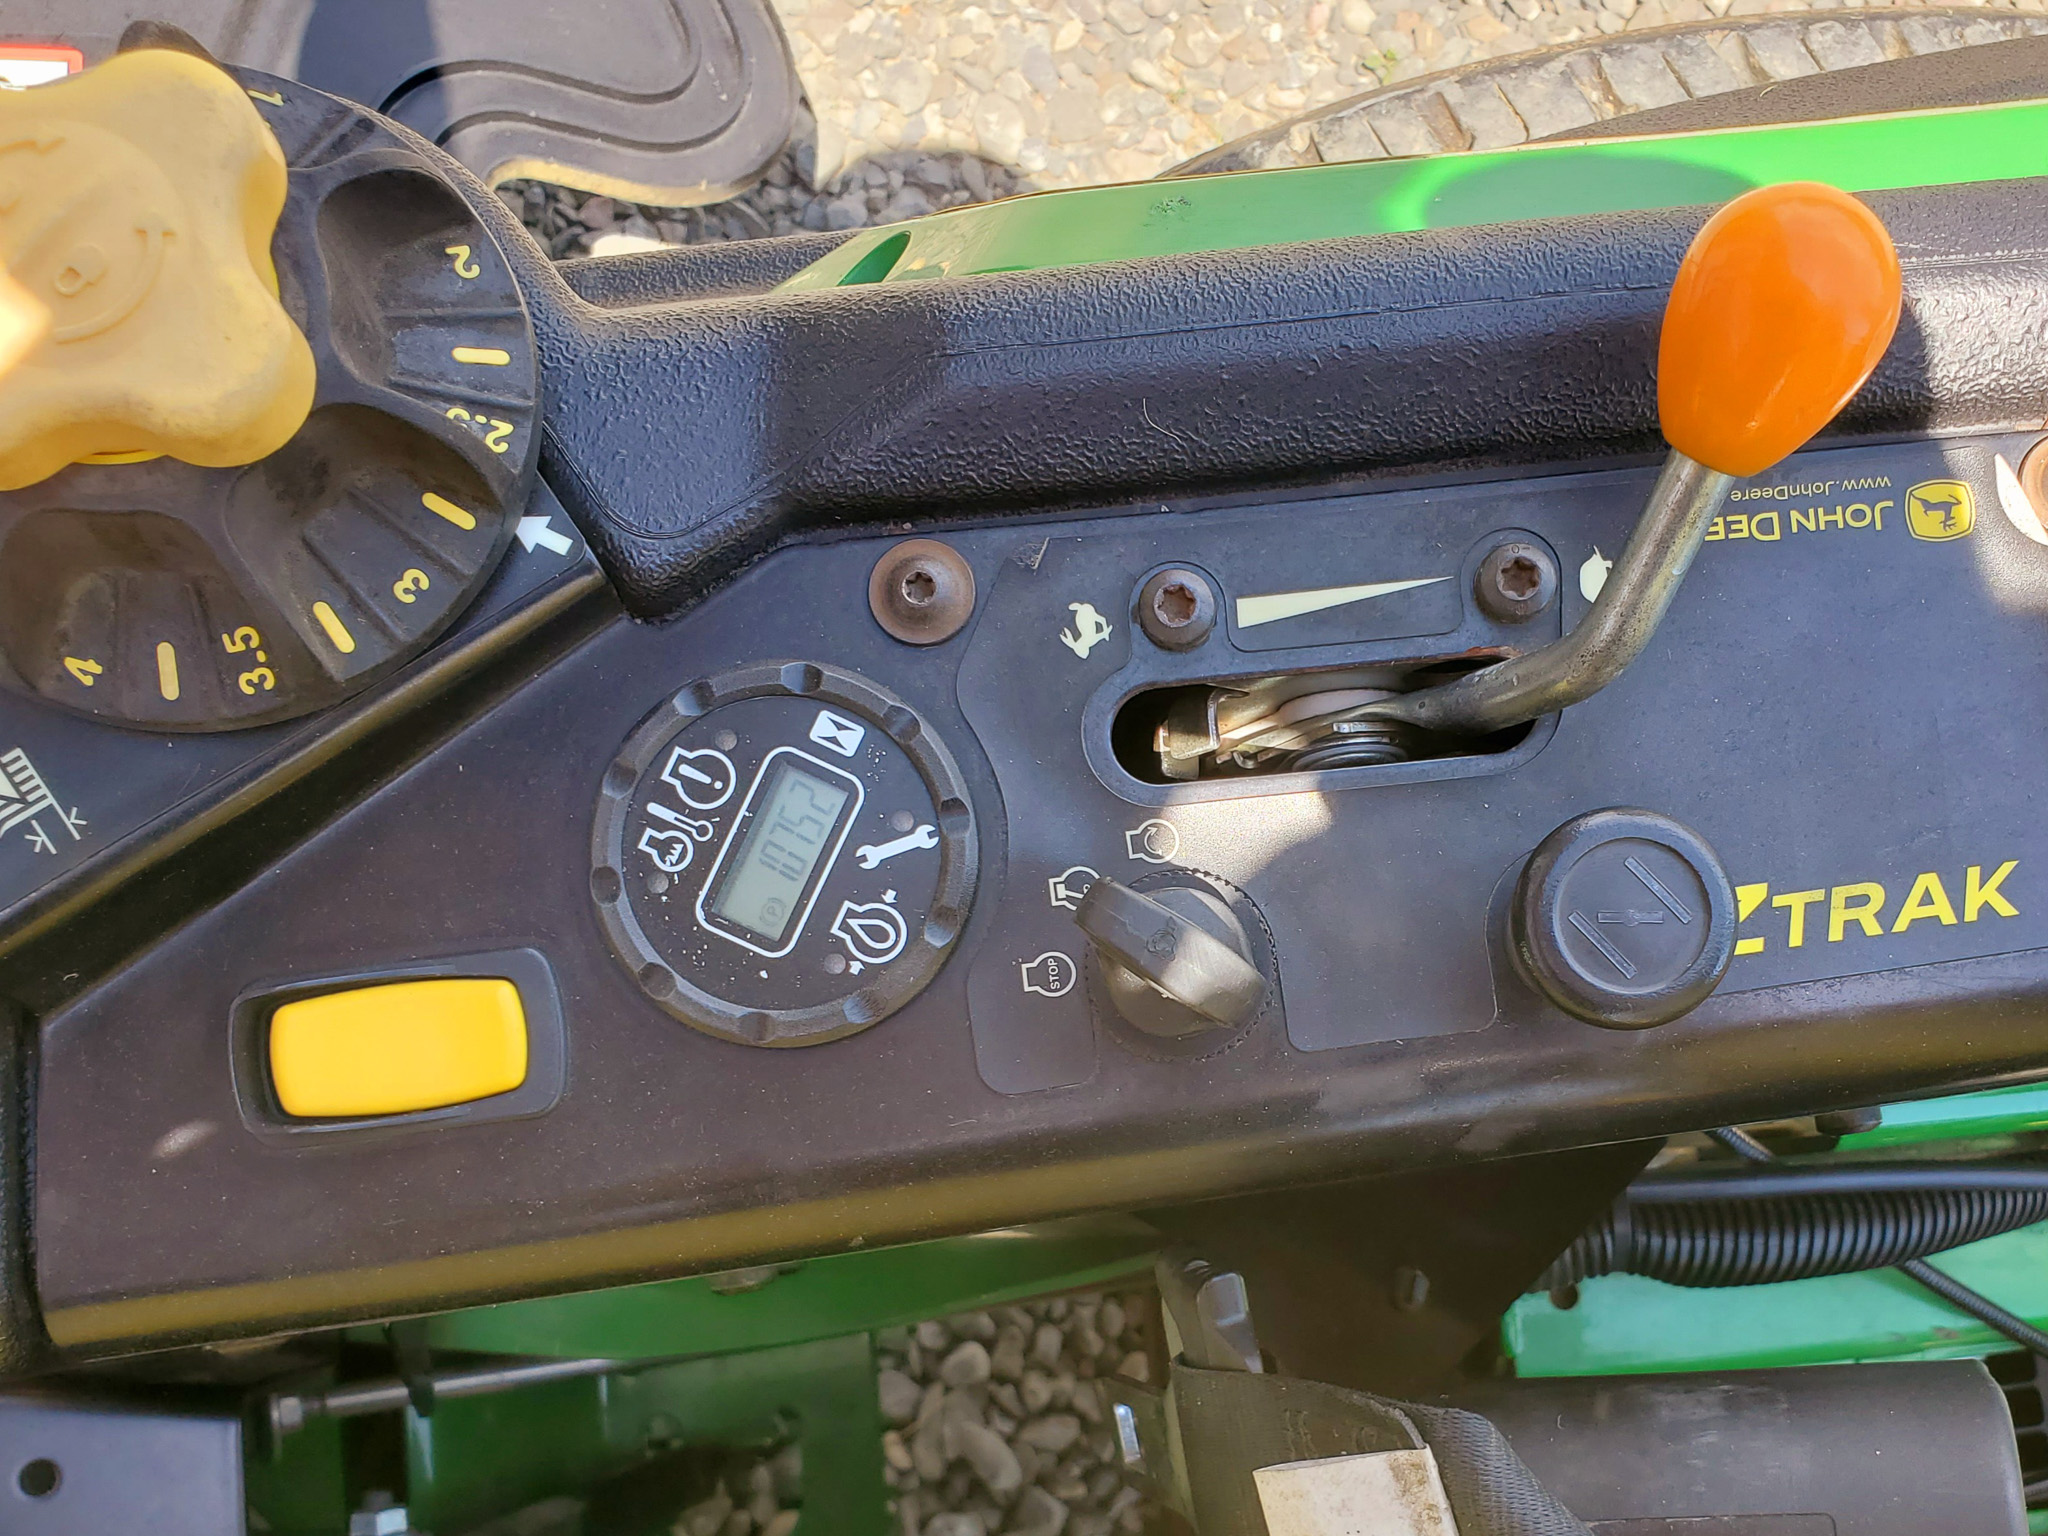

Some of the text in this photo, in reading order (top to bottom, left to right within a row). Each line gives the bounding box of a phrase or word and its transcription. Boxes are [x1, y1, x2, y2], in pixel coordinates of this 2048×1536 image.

[444, 244, 481, 279] 2
[1731, 476, 1891, 501] www.JohnDeere
[1791, 501, 1894, 533] JOHN
[392, 568, 430, 604] 3
[63, 656, 103, 687] 4
[222, 625, 275, 695] 3.5
[1047, 957, 1061, 990] STOP
